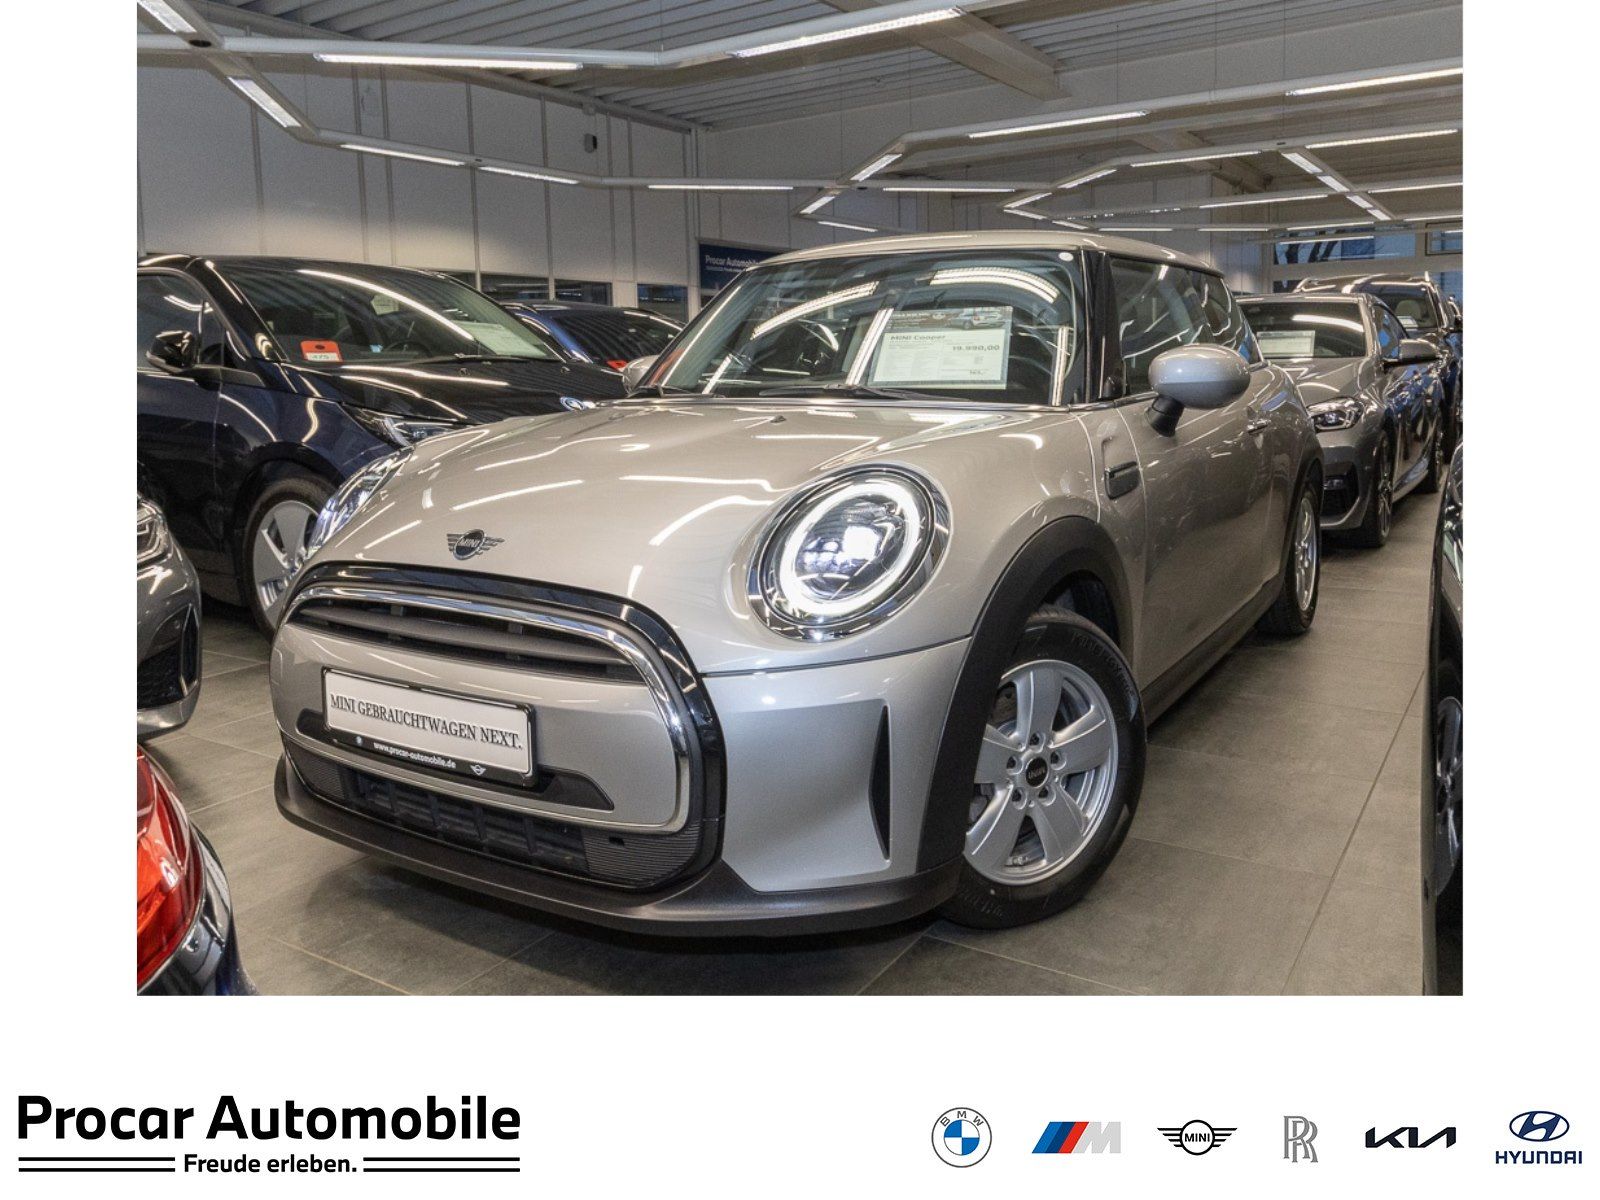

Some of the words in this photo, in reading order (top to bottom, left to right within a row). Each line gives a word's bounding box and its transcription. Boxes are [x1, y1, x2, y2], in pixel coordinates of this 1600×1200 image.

[704, 254, 726, 267] Procar
[330, 693, 356, 714] MINI
[358, 700, 476, 740] GEBRAUCHTWAGEN
[480, 728, 523, 749] NEXT.
[373, 741, 457, 769] www.procar-automobile.de
